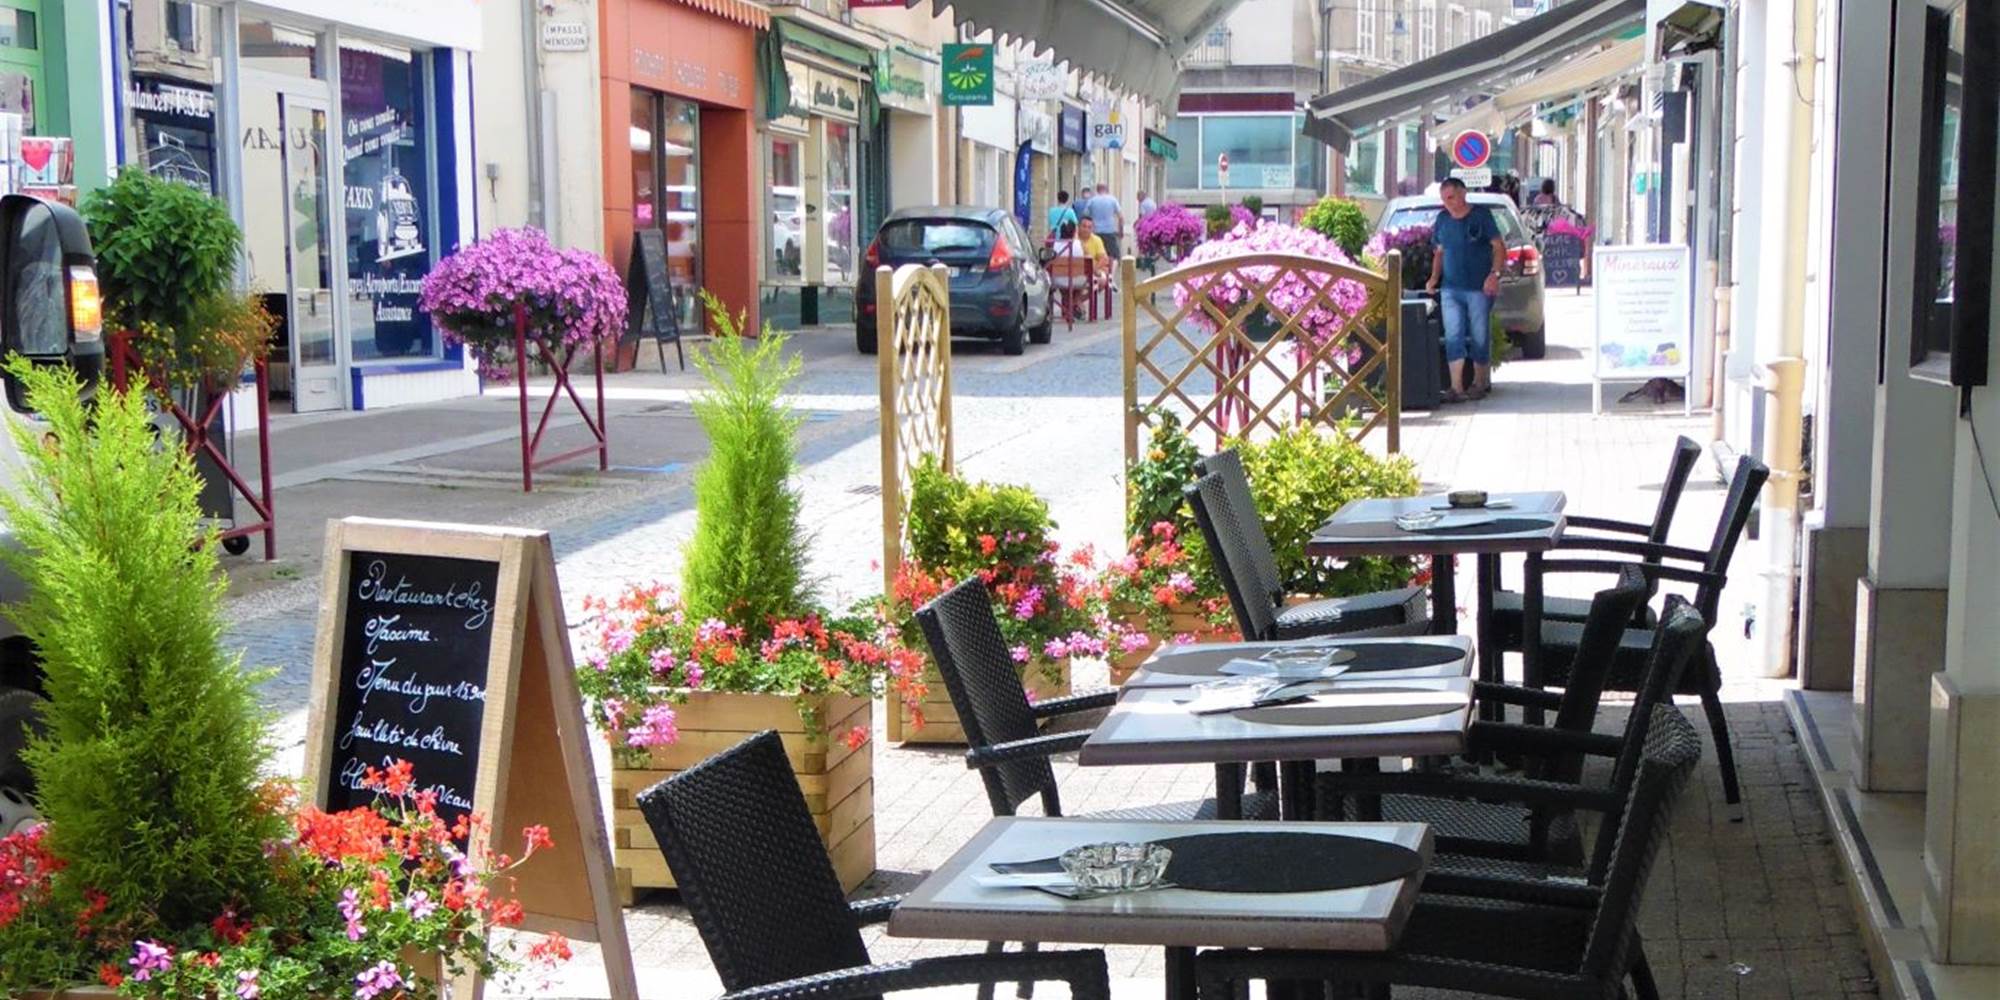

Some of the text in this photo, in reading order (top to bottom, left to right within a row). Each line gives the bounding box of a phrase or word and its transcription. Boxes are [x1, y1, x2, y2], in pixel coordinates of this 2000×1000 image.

[545, 25, 583, 34] IMPASSE
[947, 92, 987, 101] Groupama
[1094, 123, 1123, 138] gan
[343, 185, 373, 210] TAXIS
[359, 560, 455, 606] Restaurant
[356, 657, 400, 704] Menu
[401, 672, 423, 695] du
[403, 728, 418, 746] de
